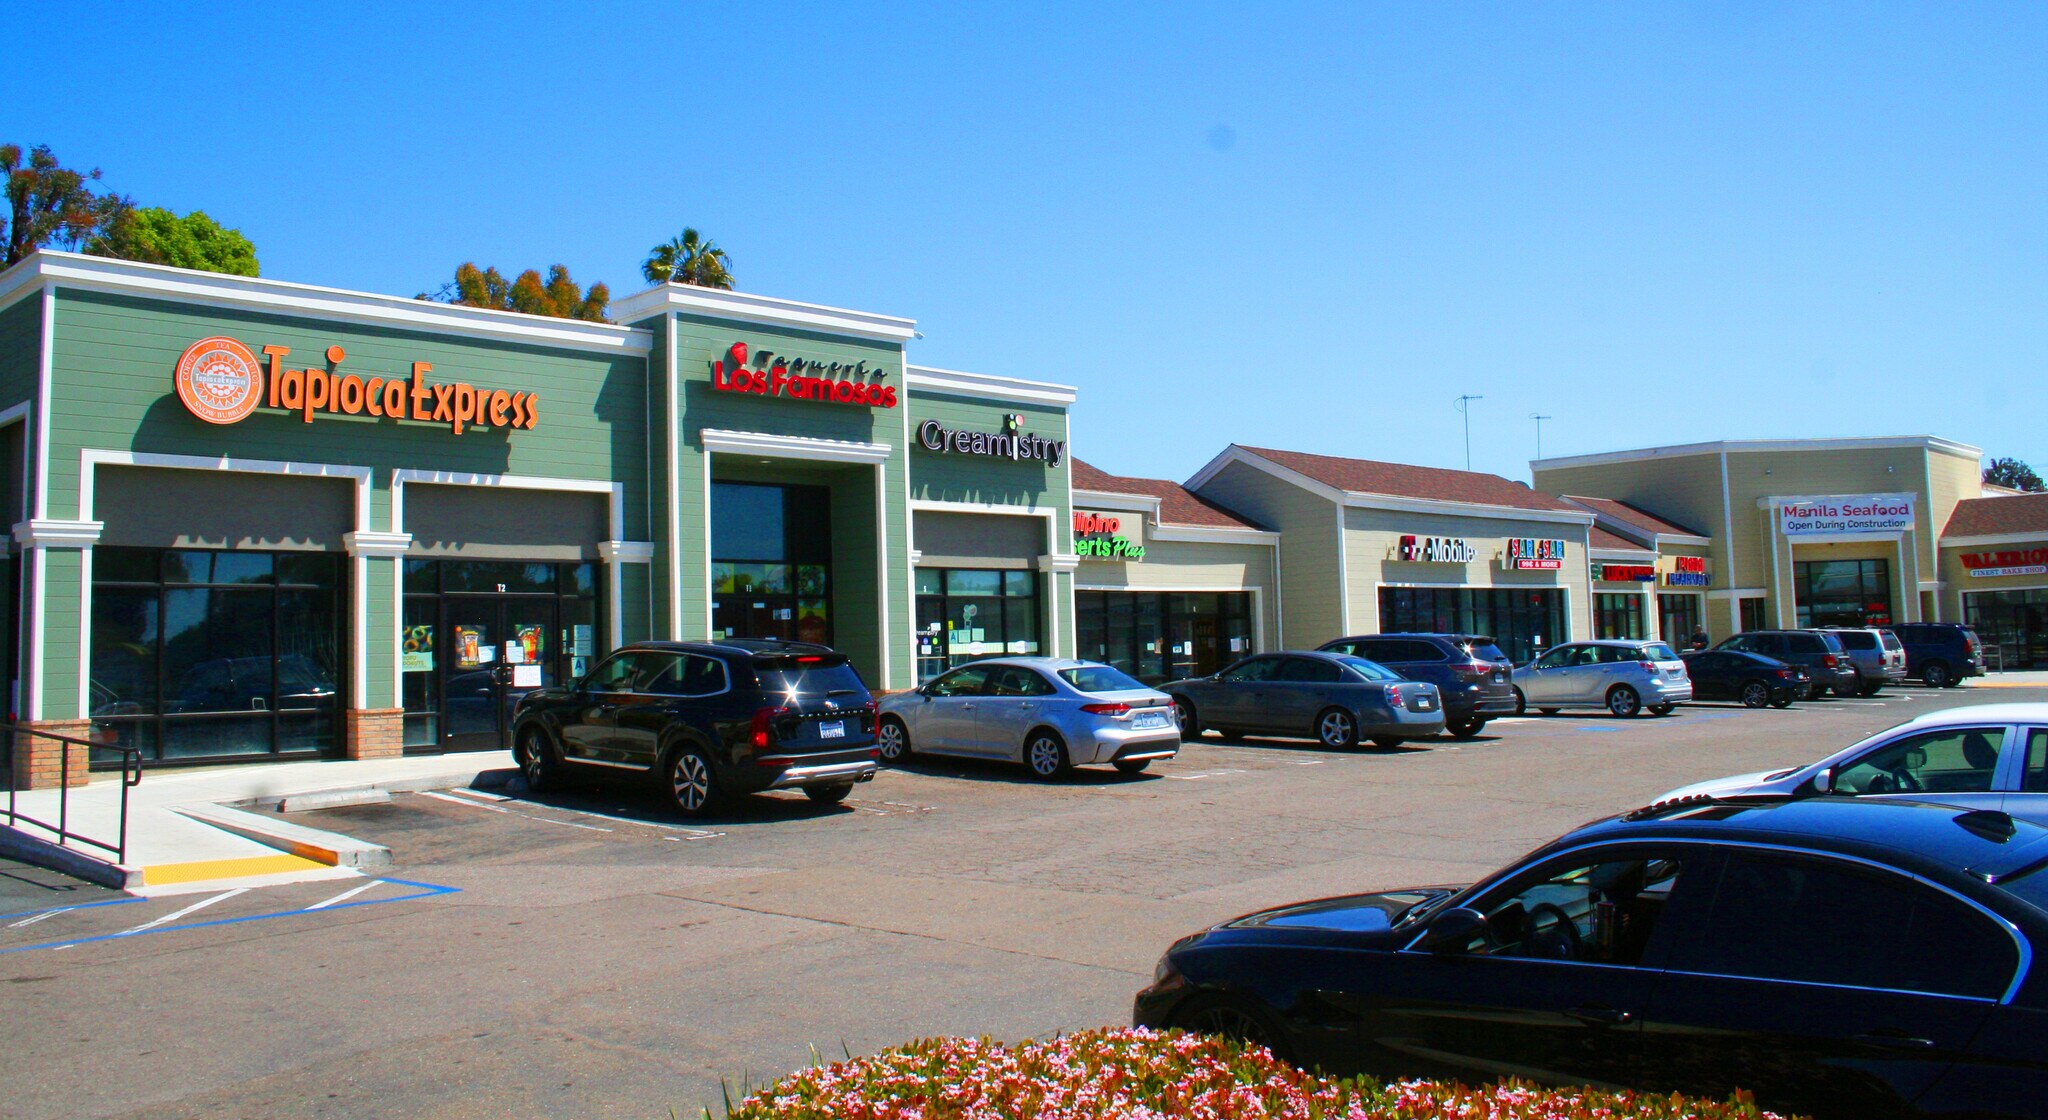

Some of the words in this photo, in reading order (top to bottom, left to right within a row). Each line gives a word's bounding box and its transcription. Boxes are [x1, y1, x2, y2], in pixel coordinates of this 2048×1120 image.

[216, 342, 230, 350] TEA
[182, 353, 198, 381] COFFEE
[247, 360, 259, 385] JUICE
[714, 360, 767, 395] Los
[771, 366, 897, 408] Famosos
[194, 401, 216, 417] SNOW
[217, 405, 246, 418] BUBBLE
[921, 414, 1067, 468] Creamistry
[1784, 505, 1838, 518] Manila
[1842, 504, 1909, 517] Seafood
[1073, 511, 1120, 537] ilipino
[1788, 521, 1813, 532] Open
[1815, 520, 1845, 531] During
[1847, 518, 1906, 529] Construction
[1112, 535, 1146, 557] Plus
[1541, 560, 1559, 568] MORE
[1972, 569, 1999, 577] FINEST
[2001, 567, 2023, 575] BAKE
[2025, 566, 2044, 574] SHOP
[575, 659, 583, 670] A
